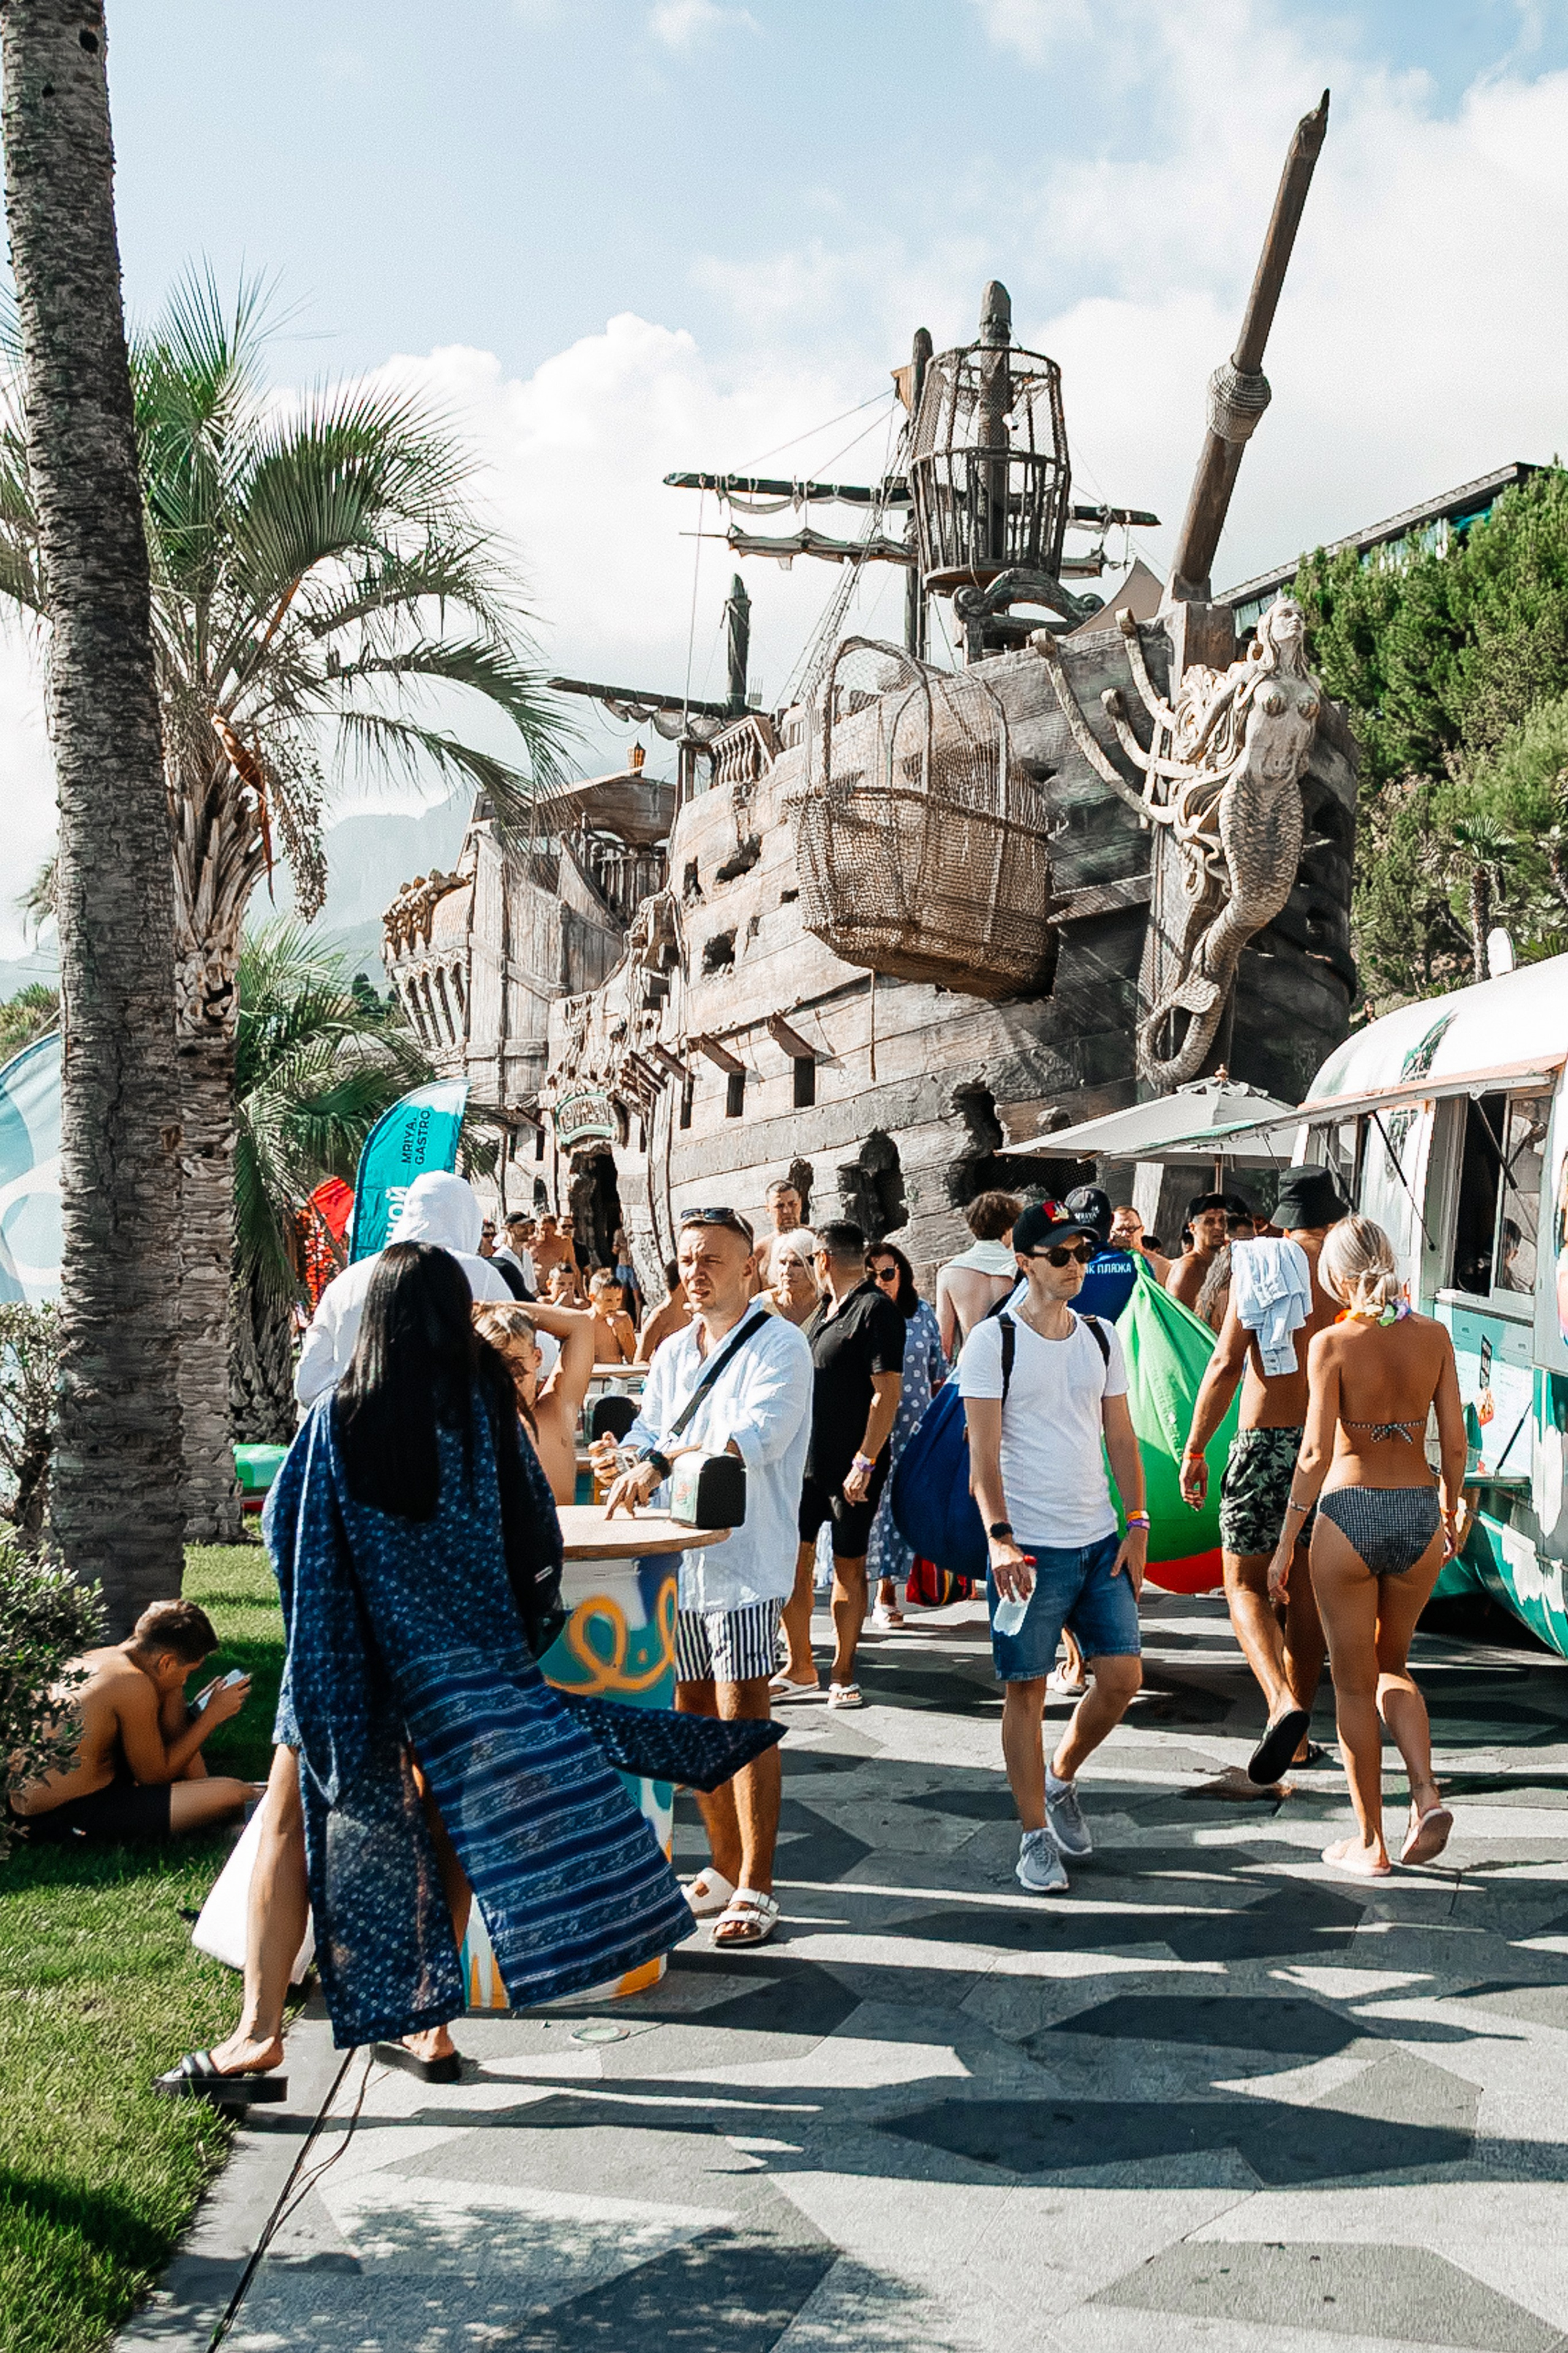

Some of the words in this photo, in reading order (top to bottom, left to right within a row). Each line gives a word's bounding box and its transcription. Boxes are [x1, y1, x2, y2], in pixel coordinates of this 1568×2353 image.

[401, 1118, 417, 1164] MRIYA.
[415, 1110, 431, 1165] GASTRO
[1097, 1262, 1132, 1274] ПЛЯЖА
